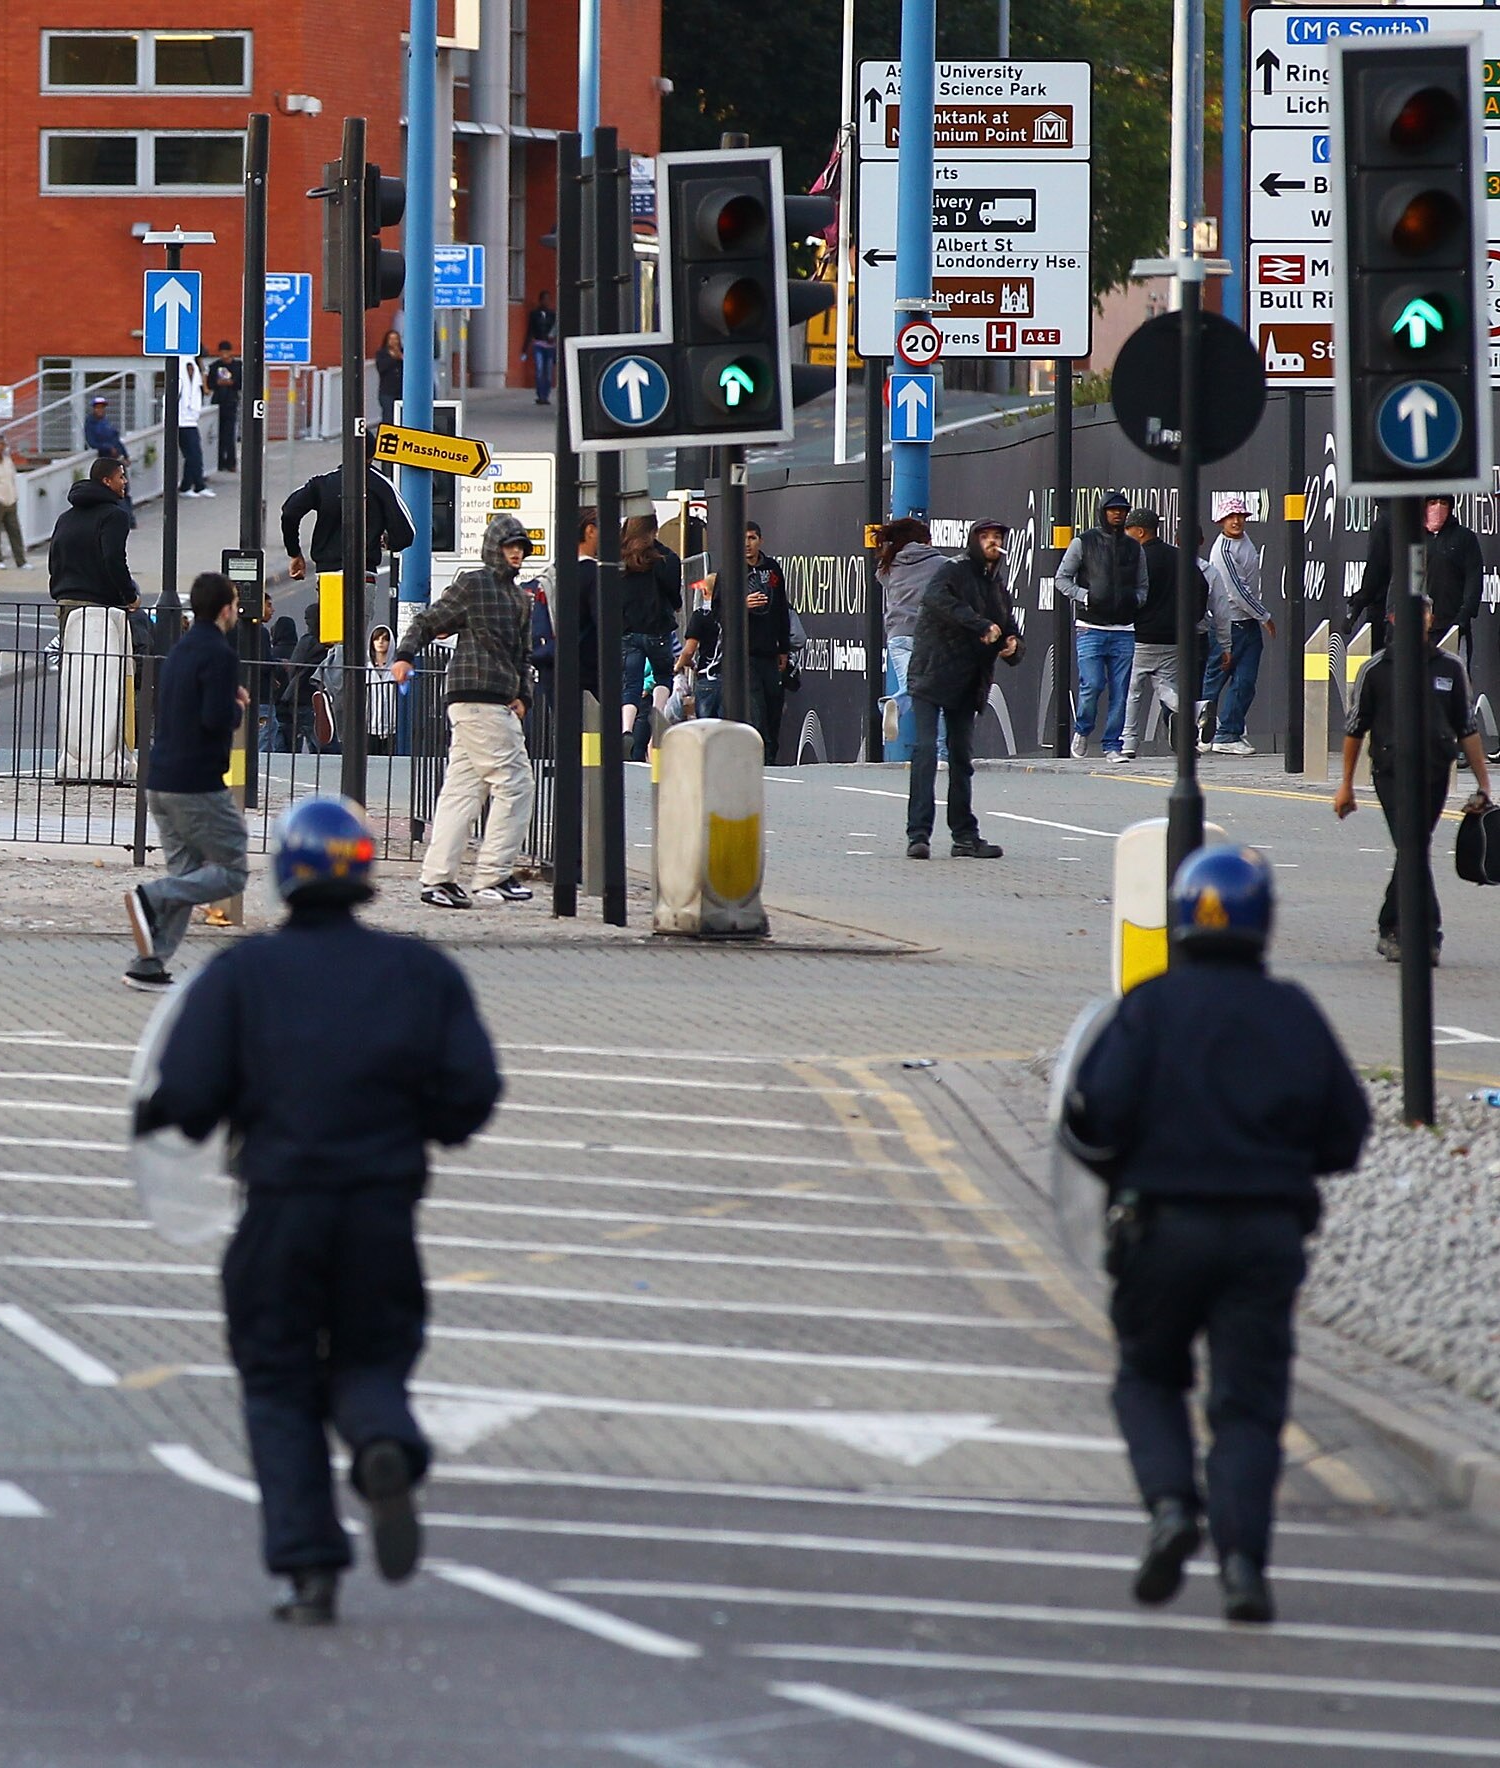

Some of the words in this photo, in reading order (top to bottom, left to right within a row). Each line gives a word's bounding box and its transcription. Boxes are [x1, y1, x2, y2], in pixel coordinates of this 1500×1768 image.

[939, 65, 1024, 81] University
[939, 82, 1004, 96] Science
[1010, 83, 1047, 96] Park
[992, 112, 1009, 125] at
[985, 128, 1027, 142] Point
[955, 213, 967, 225] D
[936, 238, 988, 252] Albert
[995, 238, 1014, 252] St
[936, 255, 1040, 271] Londonderry
[1046, 256, 1081, 269] Hse.
[1260, 292, 1303, 308] Bull
[905, 335, 936, 353] 20
[991, 324, 1012, 350] H
[402, 440, 470, 464] Masshouse
[734, 465, 745, 483] 7
[474, 484, 492, 492] road
[494, 482, 532, 494] (A4540)
[493, 497, 521, 509] (A34)
[789, 555, 835, 614] CONCEPT
